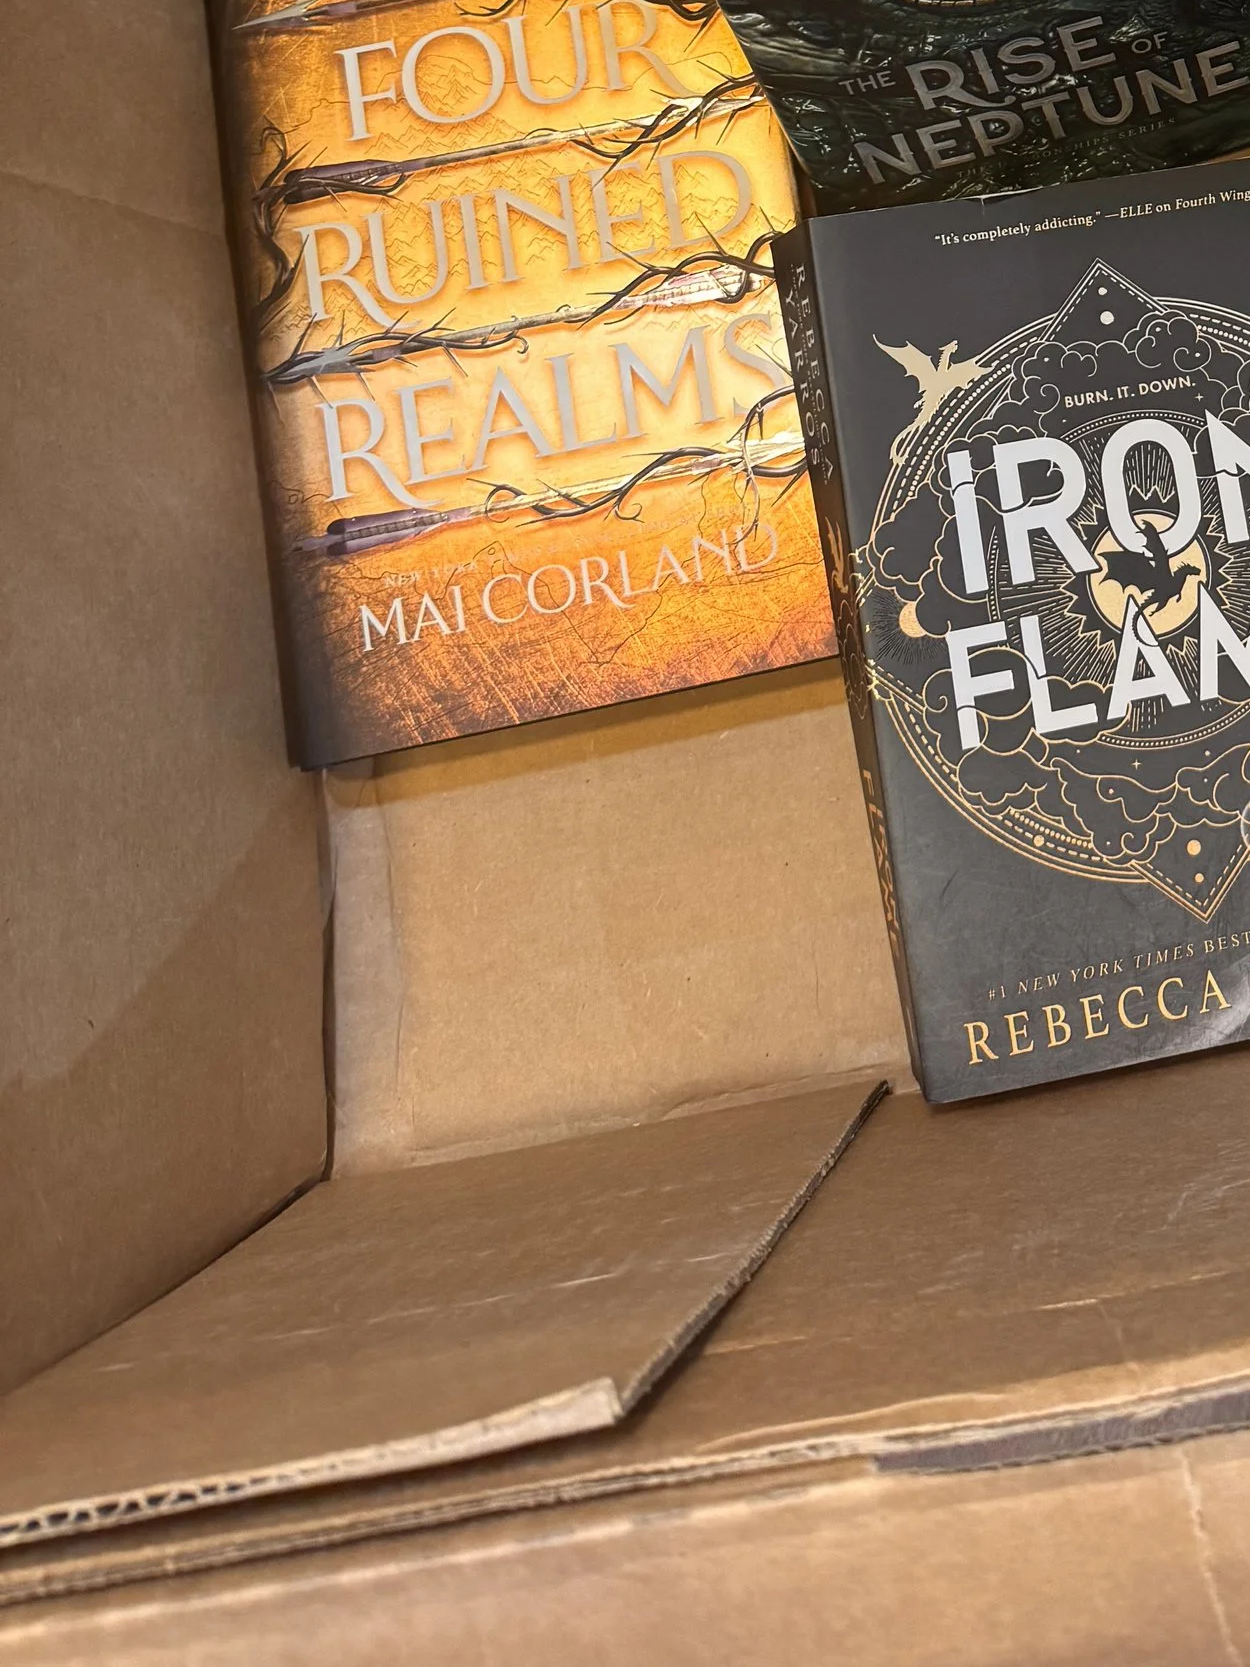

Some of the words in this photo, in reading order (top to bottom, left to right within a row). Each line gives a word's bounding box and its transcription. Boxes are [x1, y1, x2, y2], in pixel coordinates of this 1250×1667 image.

[838, 70, 897, 97] THE
[905, 15, 1117, 111] RISE
[1131, 31, 1169, 55] OF
[853, 40, 1250, 186] NEPTUNE
[1118, 117, 1176, 138] SERIES
[294, 150, 752, 330] RUINED
[962, 221, 1031, 242] completely
[1155, 201, 1171, 213] on
[1175, 193, 1216, 210] Fourth
[314, 311, 792, 510] REALMS
[785, 289, 821, 466] YARROS
[796, 264, 834, 480] REBECCA
[1064, 389, 1113, 408] BURN.
[1117, 386, 1135, 399] IT.
[1138, 375, 1196, 395] DOWN.
[359, 585, 466, 652] MAI
[482, 523, 779, 624] CORLAND
[963, 969, 1232, 1065] REBECCA
[988, 985, 1006, 1001] #1
[1017, 972, 1061, 995] NEW
[1070, 959, 1124, 983] YORK
[1133, 943, 1196, 969] TIMES
